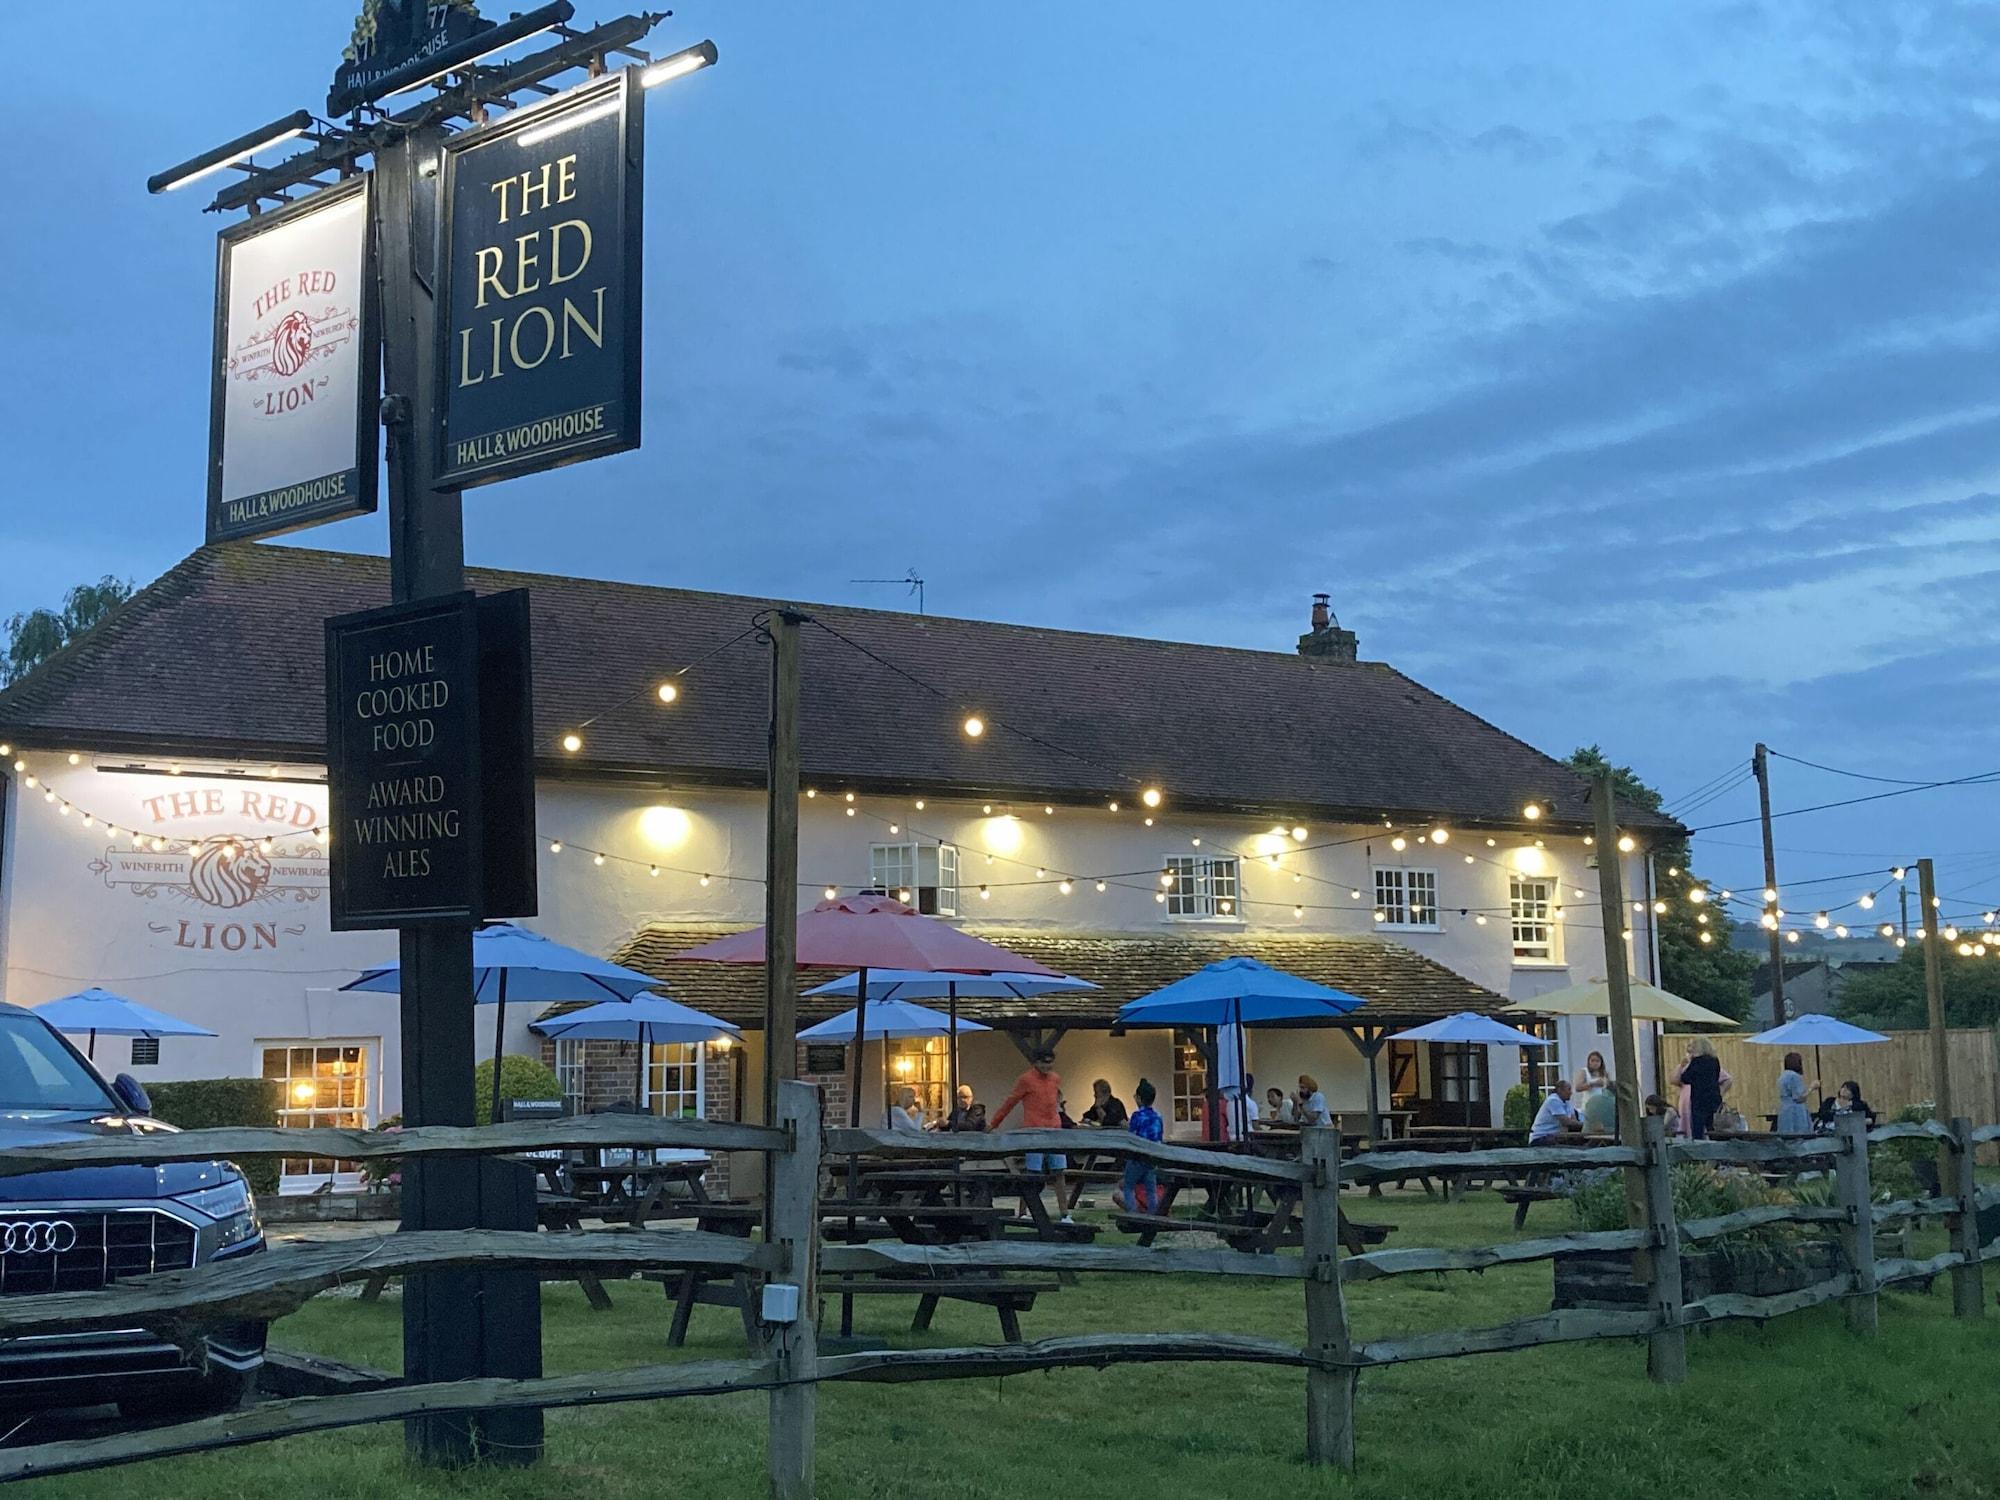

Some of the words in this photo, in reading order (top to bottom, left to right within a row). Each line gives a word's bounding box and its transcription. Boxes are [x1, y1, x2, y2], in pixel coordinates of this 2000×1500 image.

[428, 4, 448, 29] 77
[491, 153, 578, 224] THE
[474, 219, 593, 309] RED
[252, 278, 291, 320] THE
[298, 271, 337, 297] RED
[458, 287, 608, 388] LION
[265, 378, 315, 415] LION
[369, 645, 435, 682] HOME
[356, 680, 449, 719] COOKED
[373, 718, 435, 751] FOOD
[142, 789, 225, 824] THE
[240, 790, 317, 829] RED
[367, 775, 445, 809] AWARD
[354, 809, 460, 845] WINNING
[120, 861, 184, 873] WINFRITH
[272, 866, 330, 877] NEWBURG
[383, 848, 431, 879] ALES
[175, 919, 278, 951] LION
